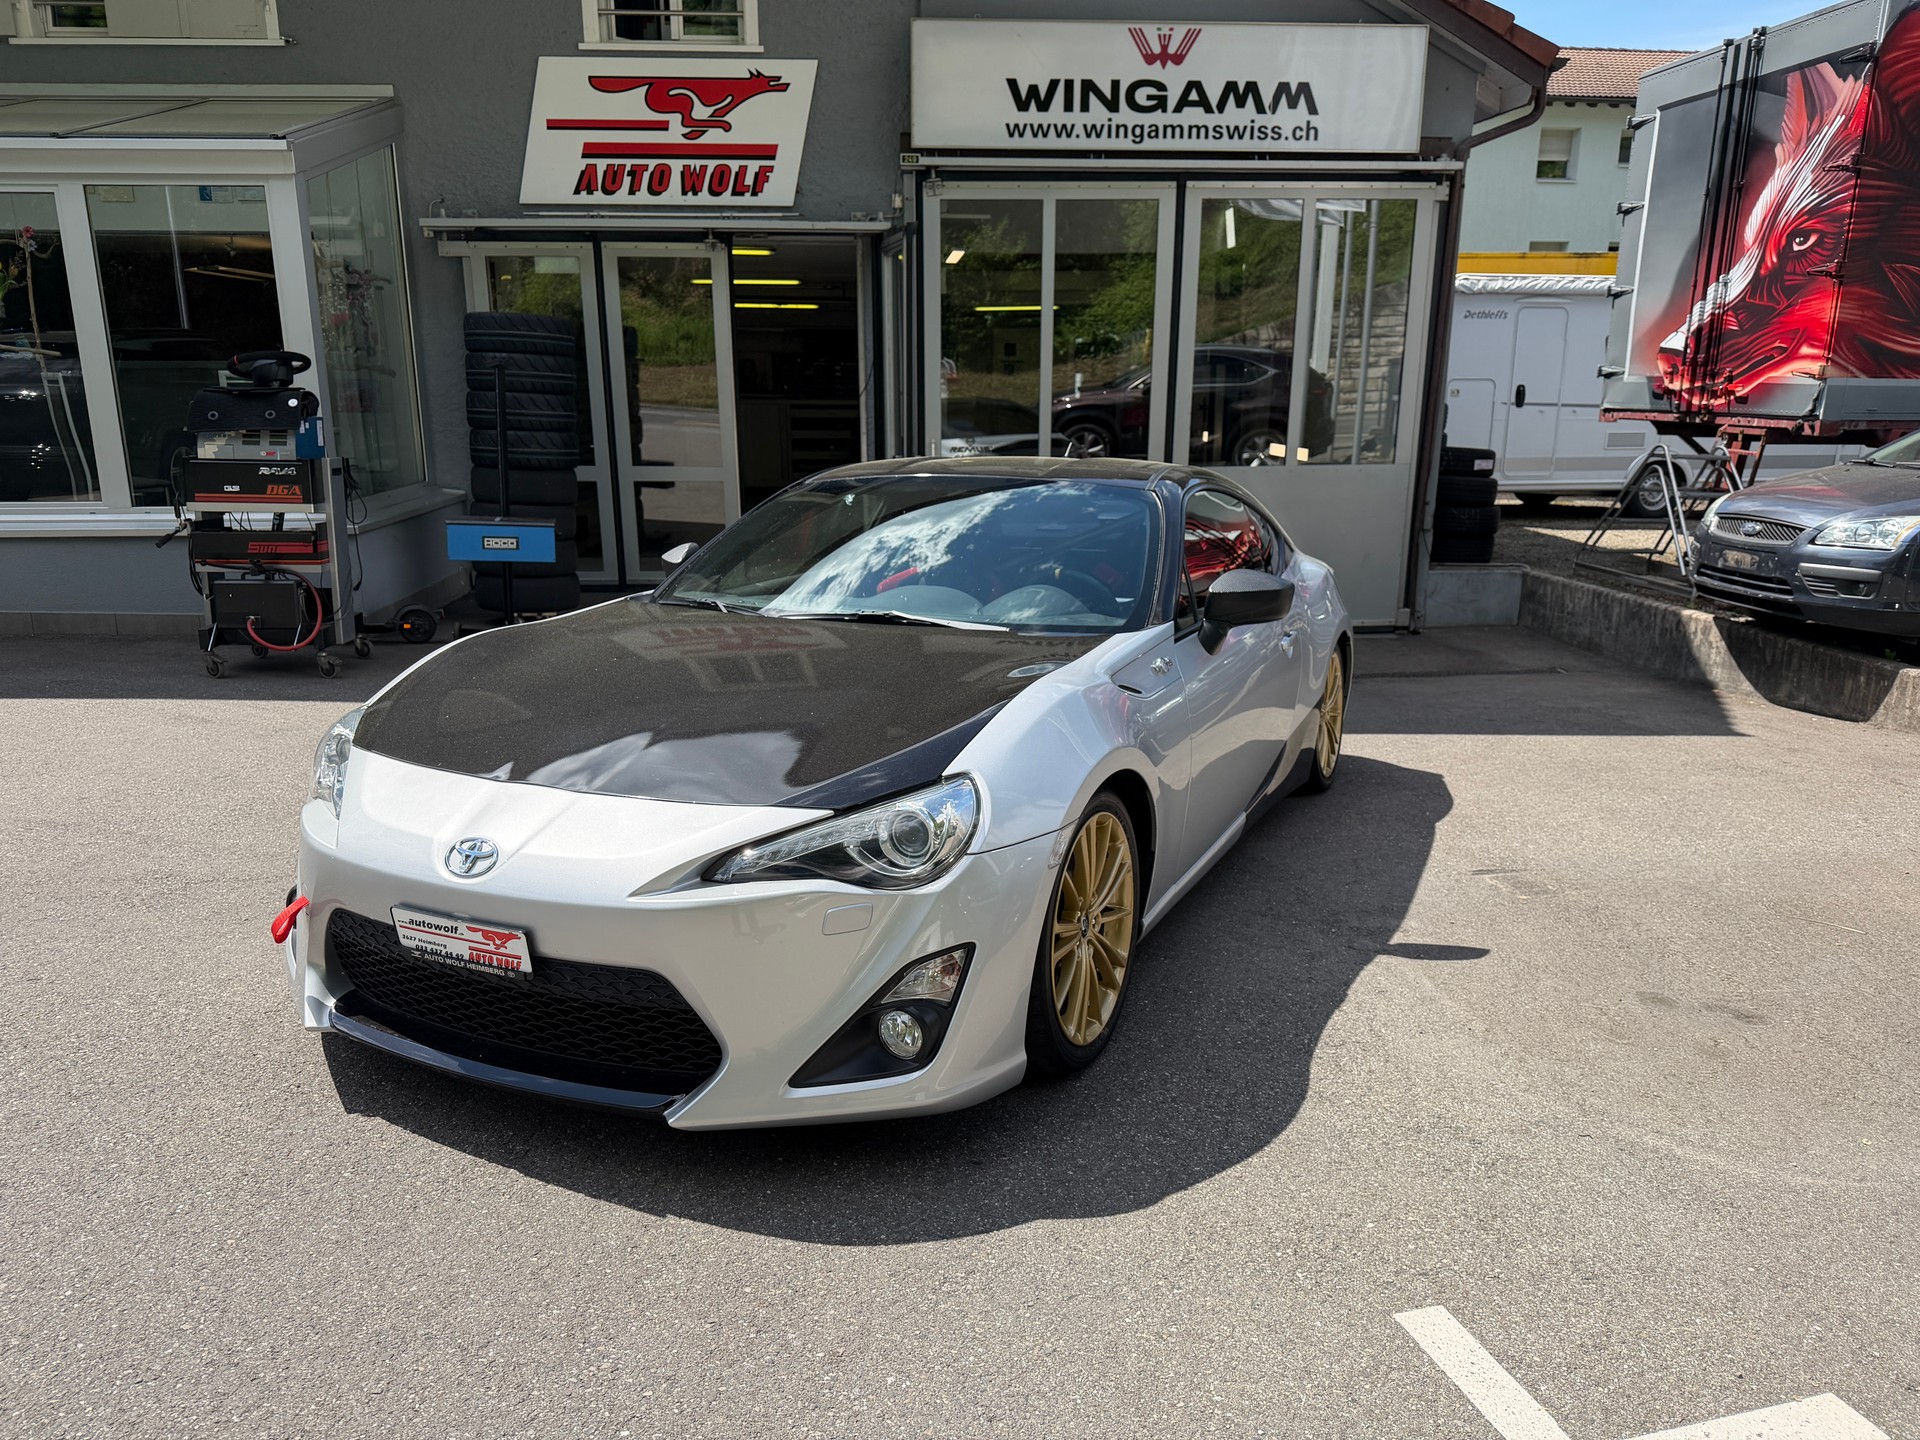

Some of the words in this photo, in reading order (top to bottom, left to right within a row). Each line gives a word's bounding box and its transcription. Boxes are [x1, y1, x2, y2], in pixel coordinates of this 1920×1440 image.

[1005, 78, 1319, 115] WINGAMM
[1005, 118, 1319, 144] www.wingammswiss.ch
[573, 163, 672, 196] AUTO
[680, 164, 774, 197] WOLF
[1464, 310, 1509, 320] Dethleffs
[266, 484, 301, 495] DGA
[417, 937, 448, 949] Heimberg
[424, 953, 444, 962] AUTO
[445, 958, 466, 967] WOLF
[466, 962, 505, 976] HEIMBERG
[469, 952, 494, 965] AUTO
[496, 957, 522, 970] WOLF
